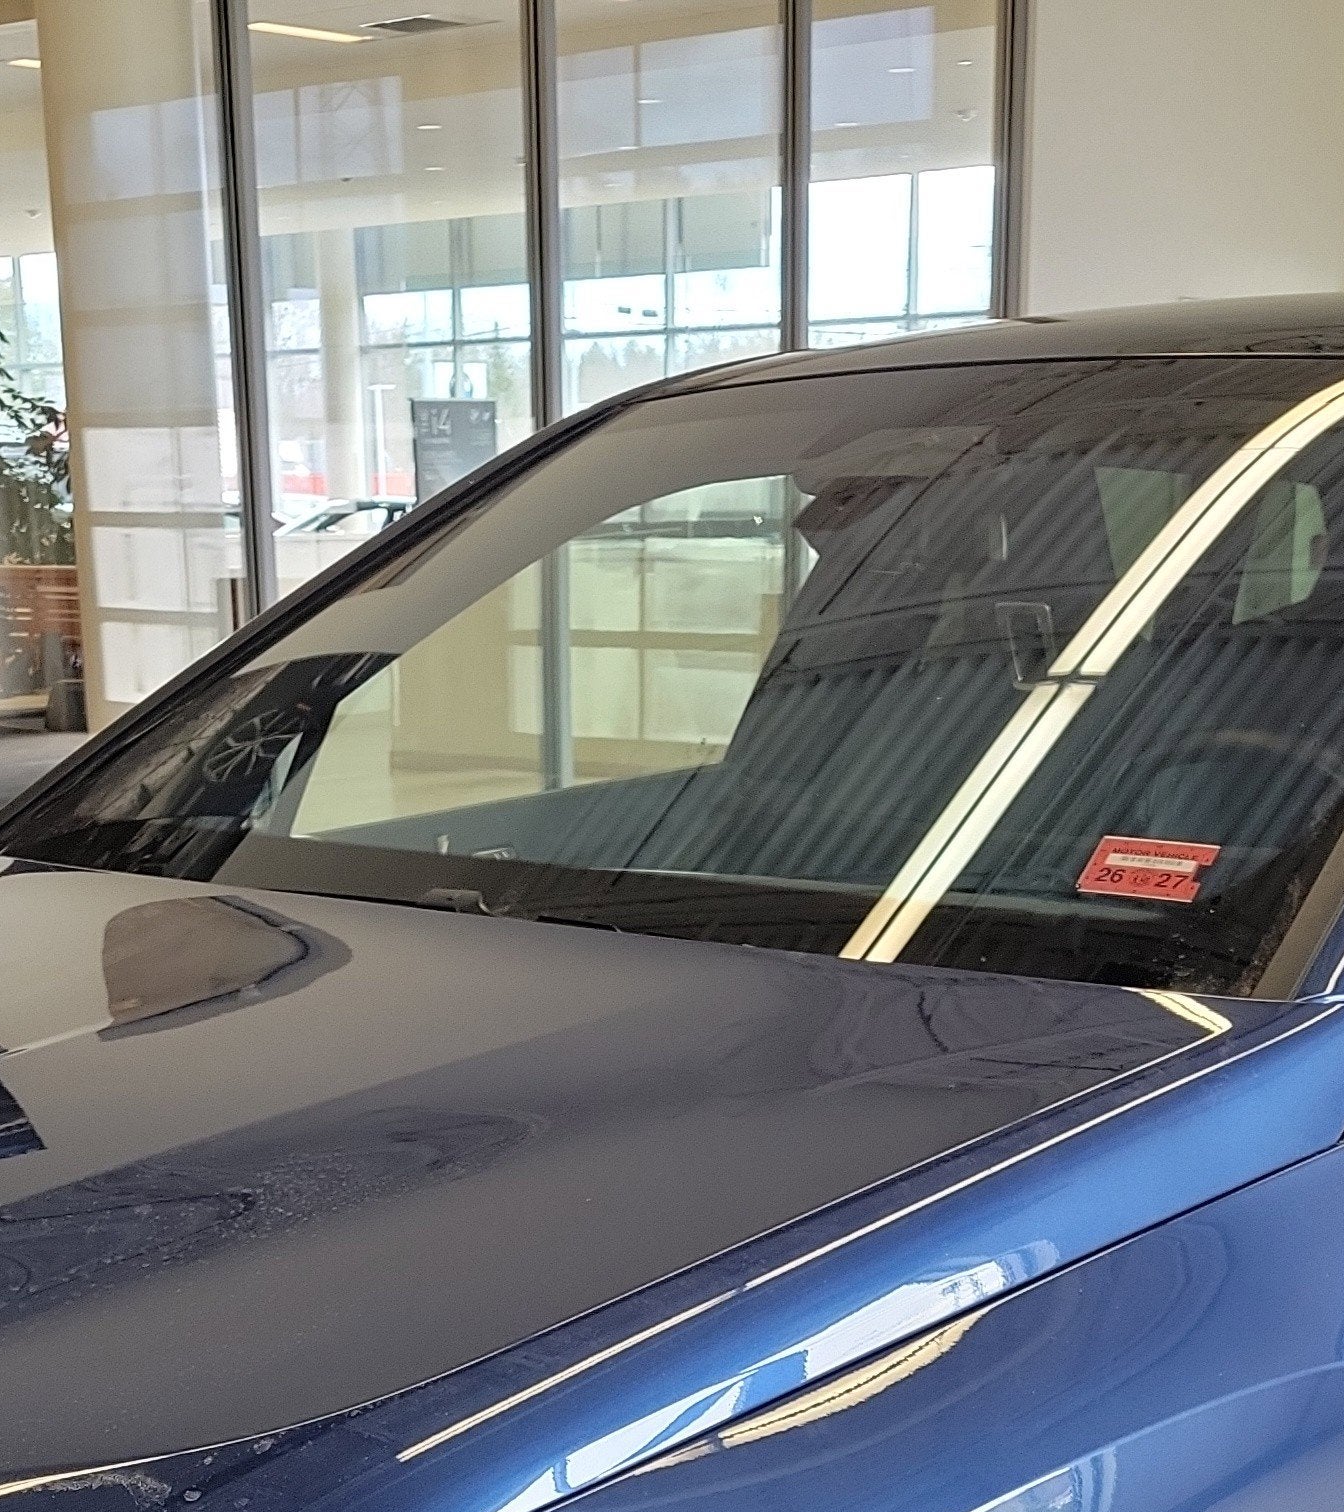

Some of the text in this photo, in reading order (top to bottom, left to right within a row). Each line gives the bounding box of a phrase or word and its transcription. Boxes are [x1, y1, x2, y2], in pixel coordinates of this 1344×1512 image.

[1112, 847, 1199, 861] MOTOR VEHICLE
[1094, 868, 1189, 890] 26 27
